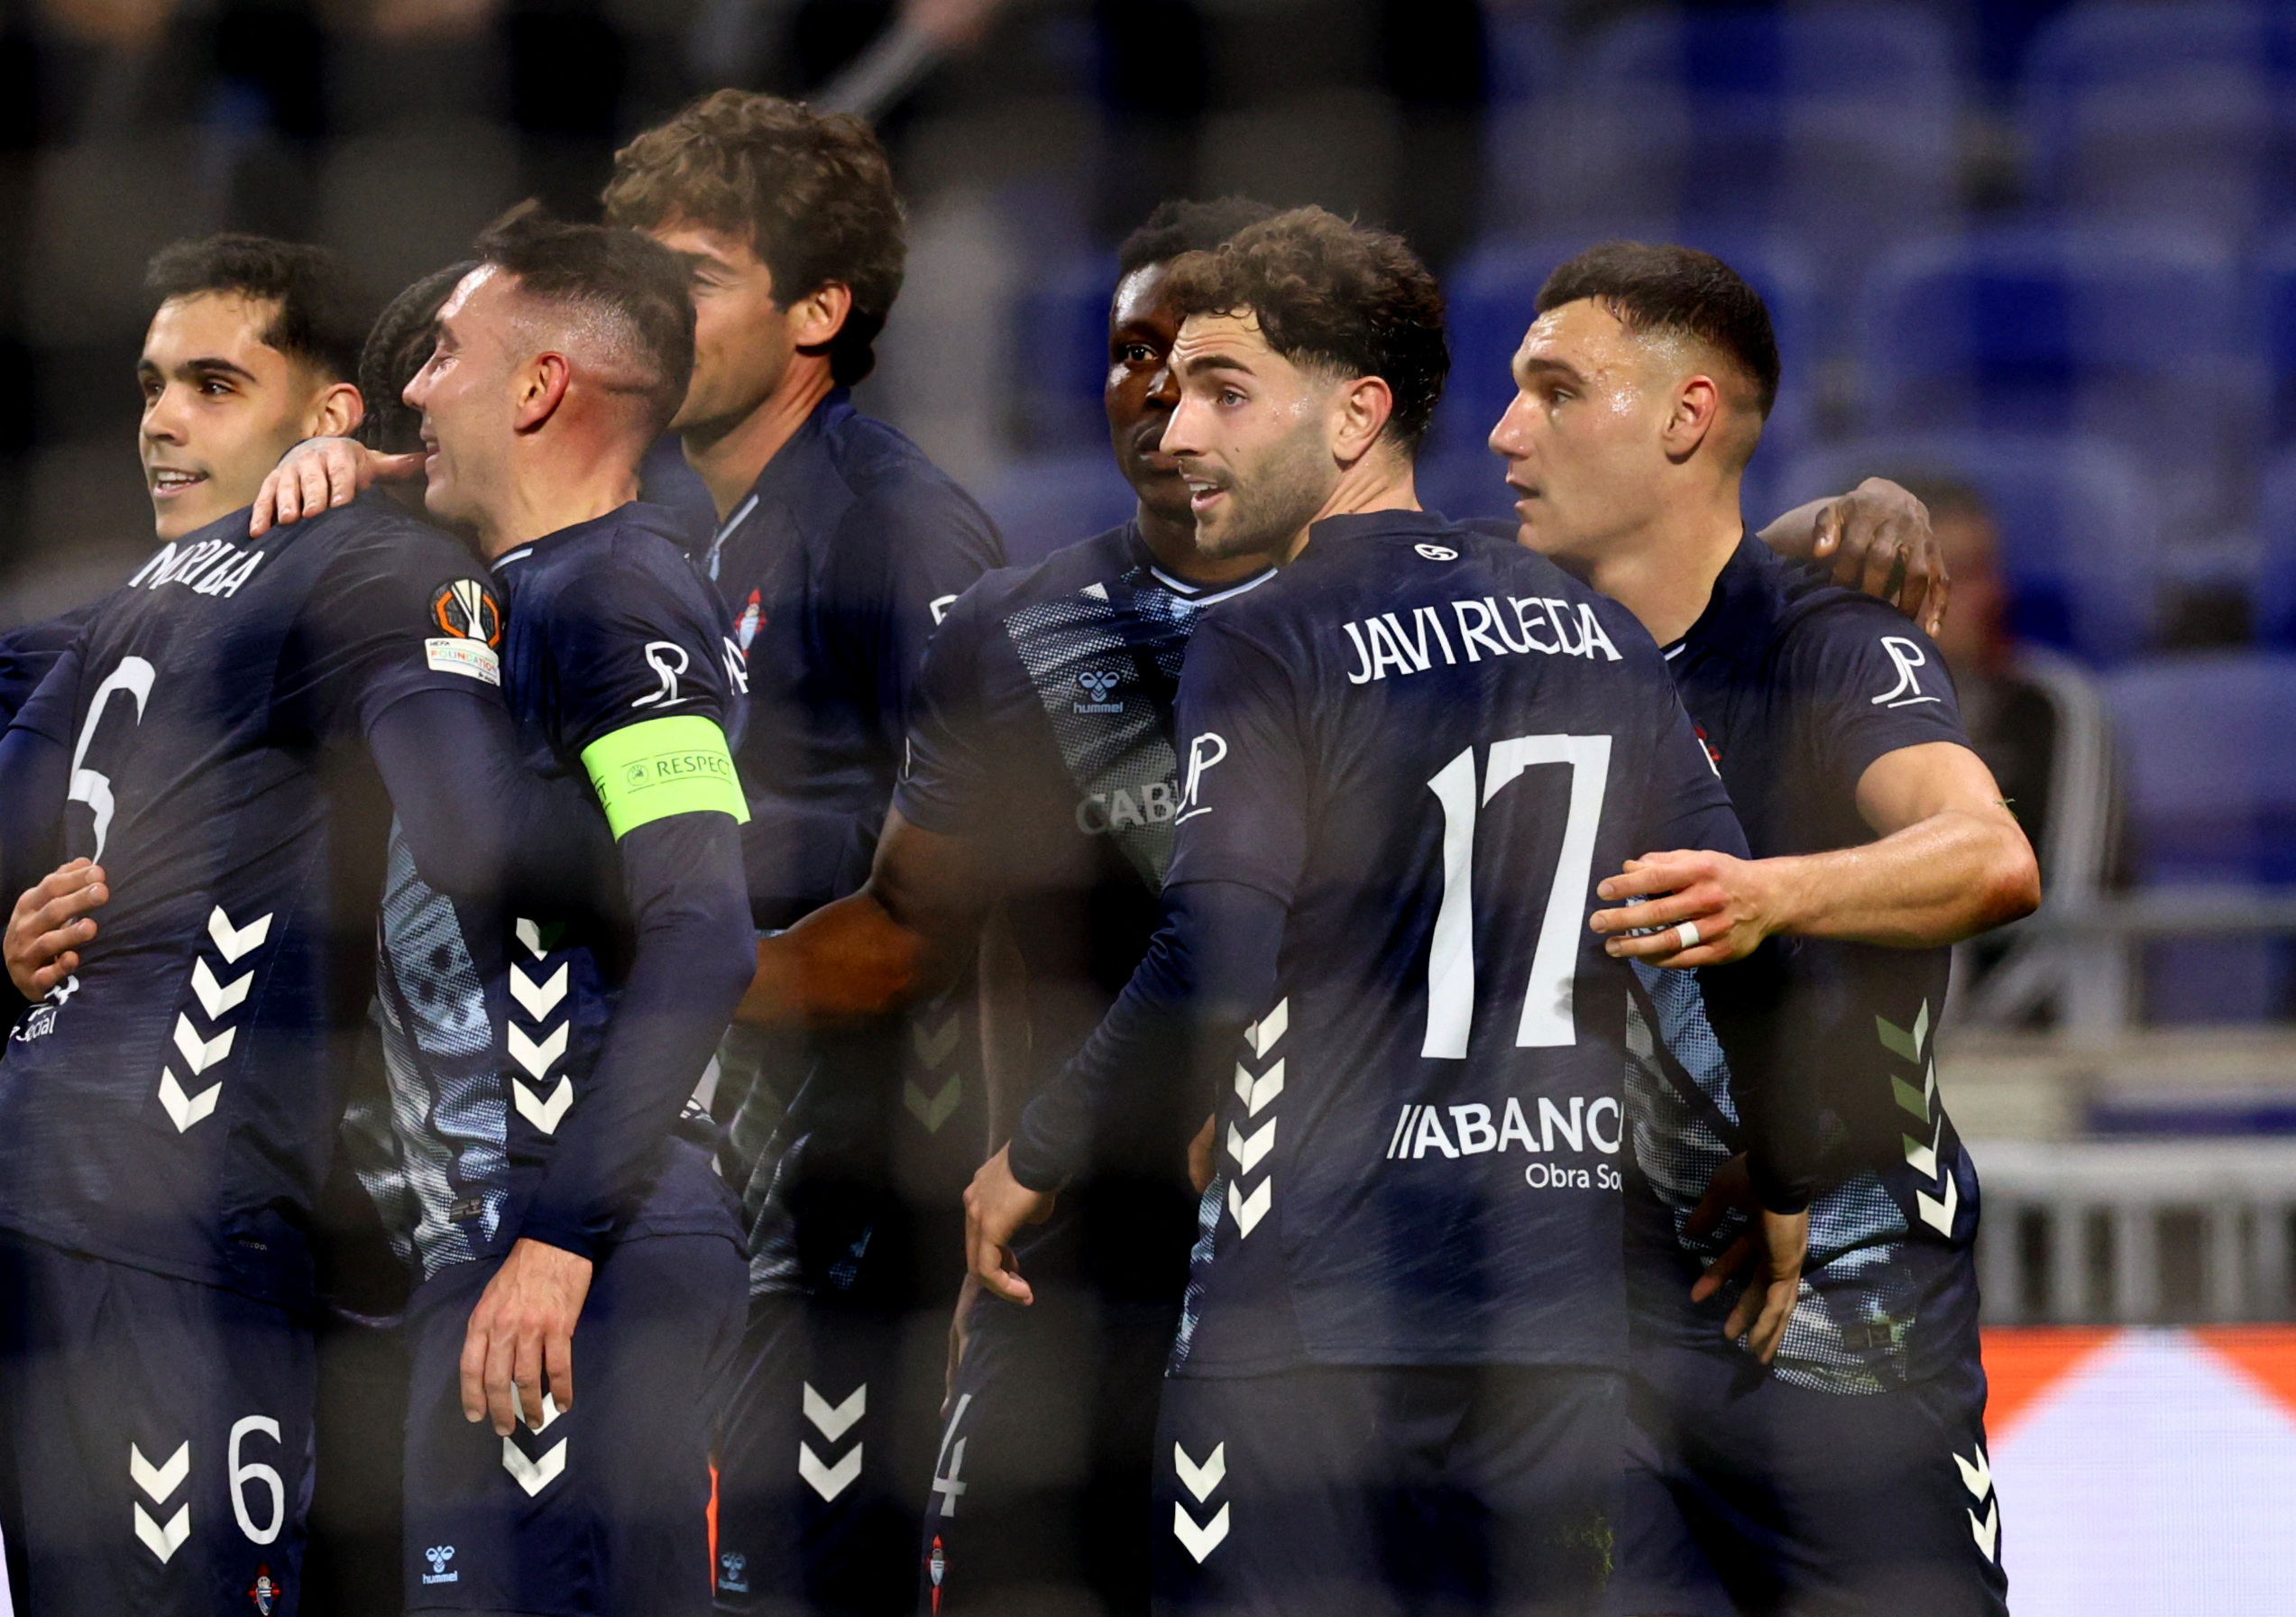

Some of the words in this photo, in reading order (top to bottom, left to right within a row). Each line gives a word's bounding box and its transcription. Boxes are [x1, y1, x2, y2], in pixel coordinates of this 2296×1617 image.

[1343, 606, 1457, 684] JAVI
[1451, 596, 1624, 663] RUEDA
[1073, 702, 1124, 713] hummel
[1076, 779, 1180, 835] CAB
[1421, 733, 1613, 1060] 17
[1526, 1162, 1590, 1189] Obra
[228, 1415, 285, 1545] 6
[932, 1392, 972, 1518] 4
[422, 1570, 458, 1585] hummel
